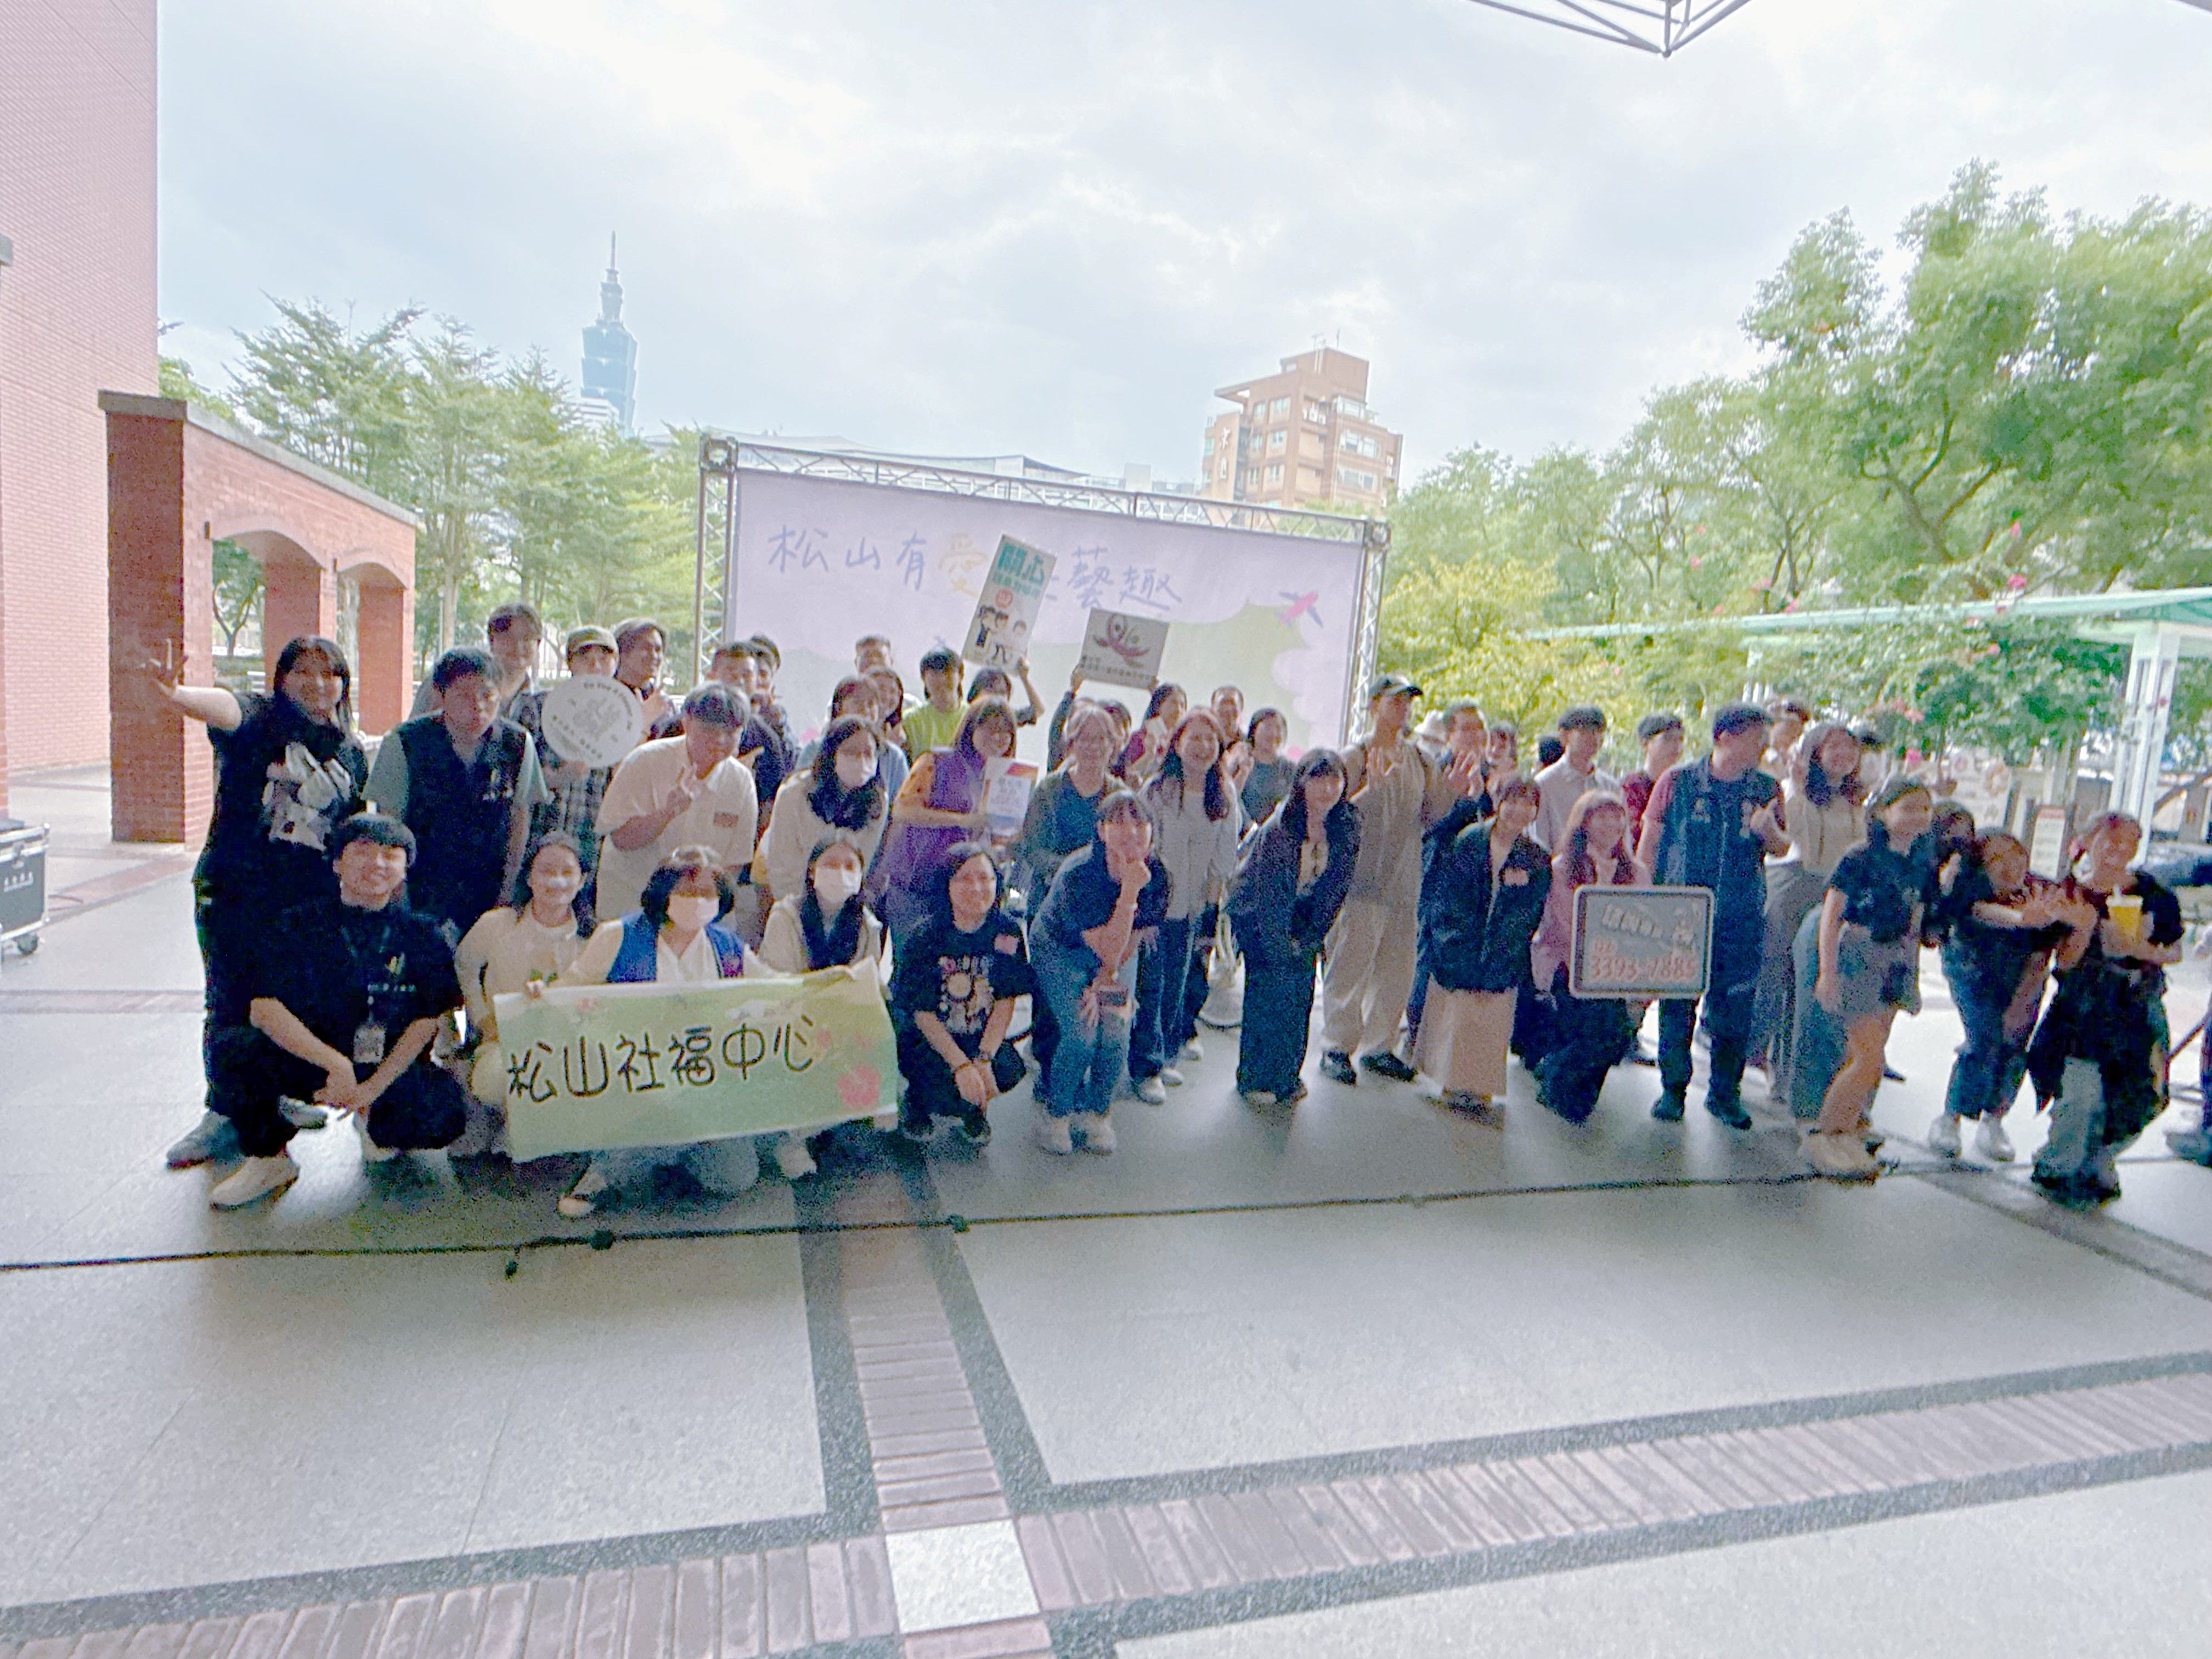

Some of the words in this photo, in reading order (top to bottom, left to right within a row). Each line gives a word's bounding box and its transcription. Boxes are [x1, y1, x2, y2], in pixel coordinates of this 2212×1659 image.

[768, 524, 1182, 610] 松山有愛藝趣
[507, 1014, 814, 1102] 松山社福中心
